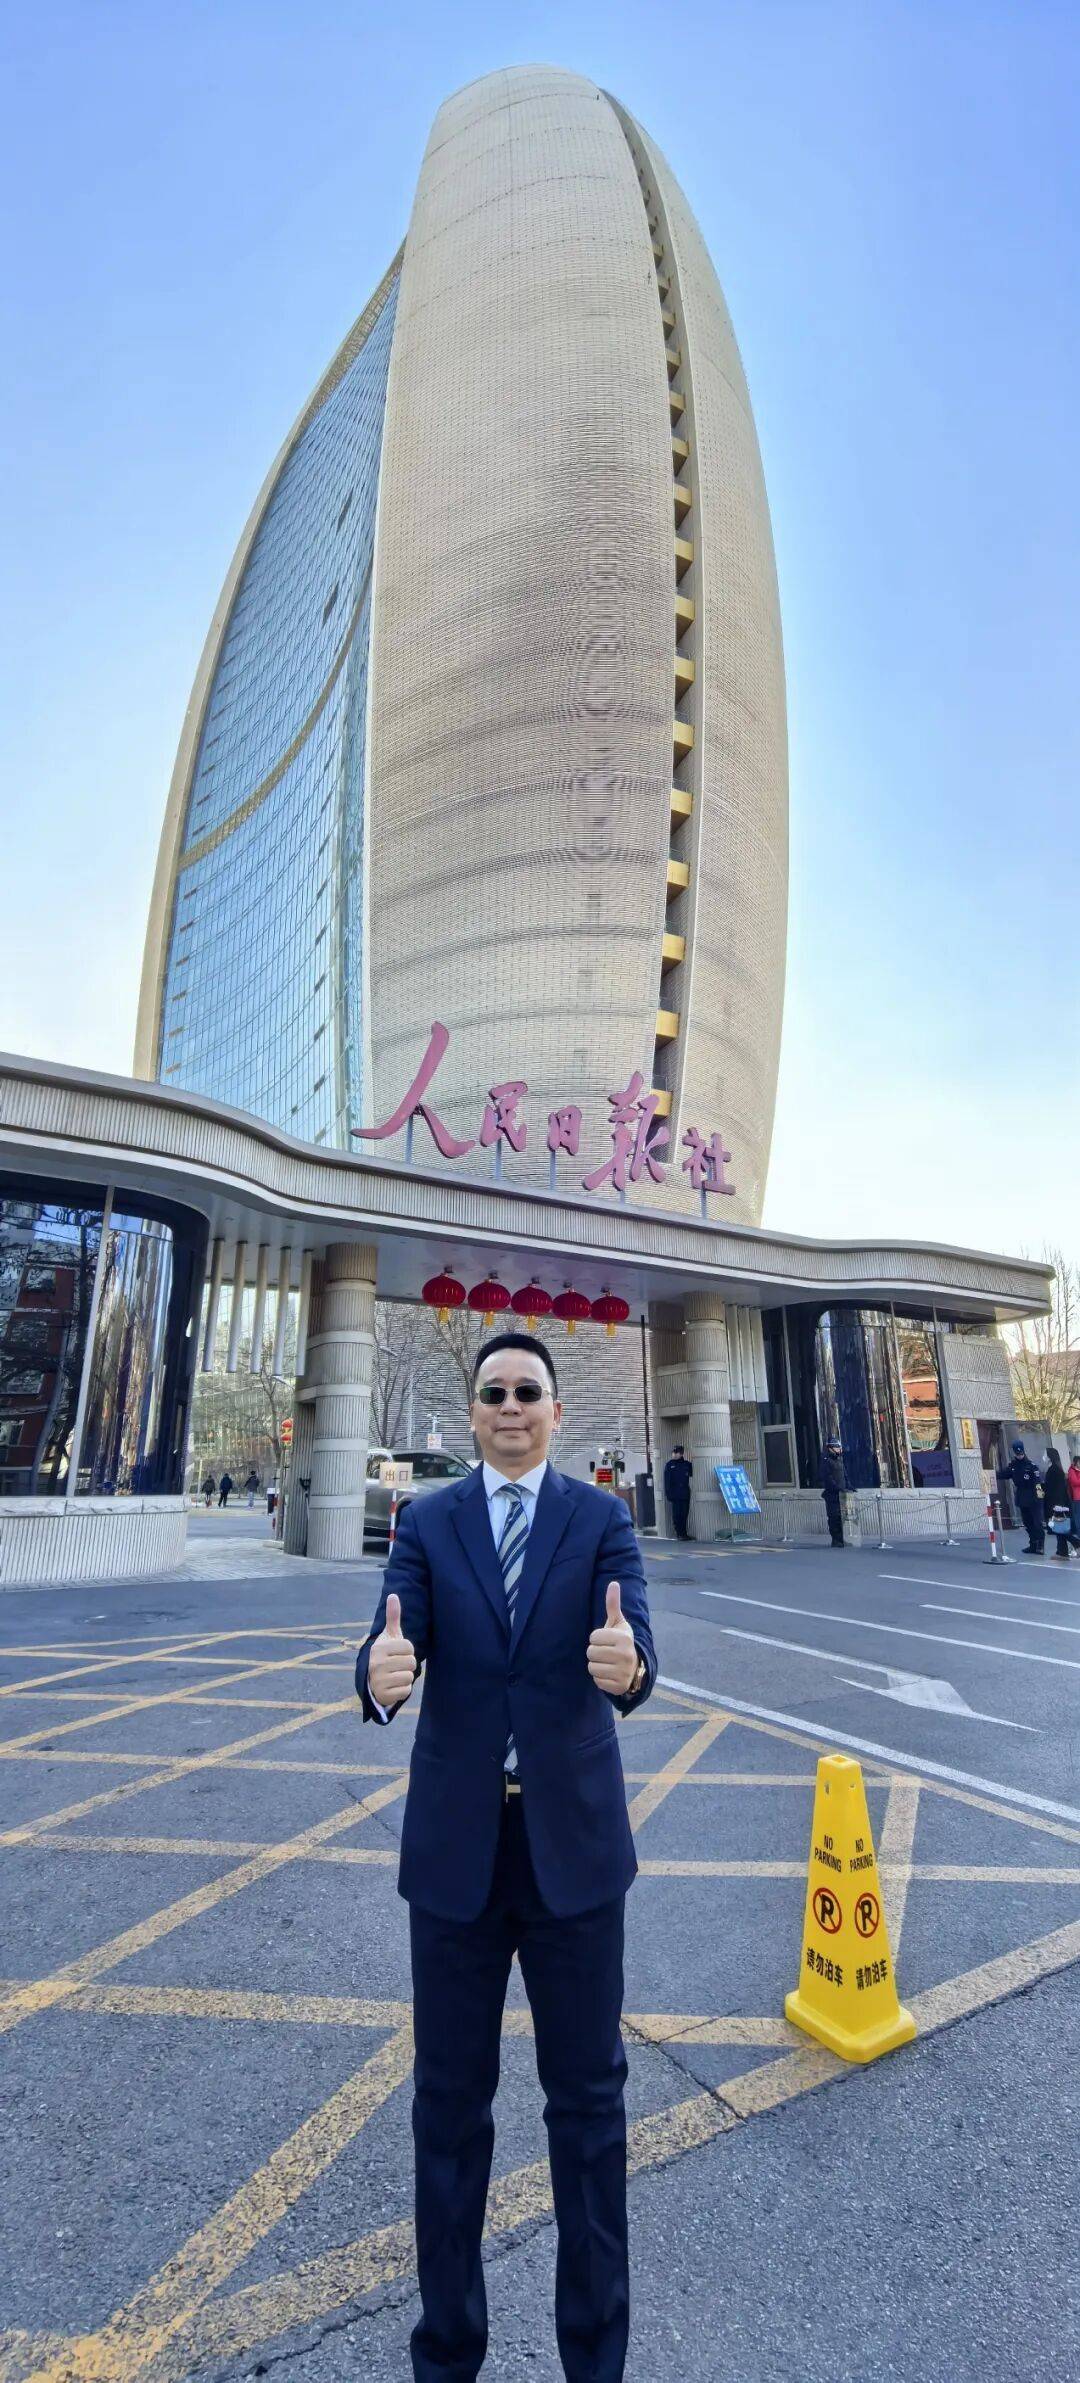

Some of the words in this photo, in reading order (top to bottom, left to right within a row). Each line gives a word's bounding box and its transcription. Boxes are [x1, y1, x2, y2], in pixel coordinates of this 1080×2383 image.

[385, 1469, 409, 1482] 出口
[823, 1835, 834, 1850] NO
[855, 1838, 864, 1853] NO
[814, 1847, 842, 1872] PARKING
[849, 1854, 874, 1872] PARKING
[806, 1947, 843, 1988] 请勿泊车
[855, 1958, 888, 1991] 请勿泊车
